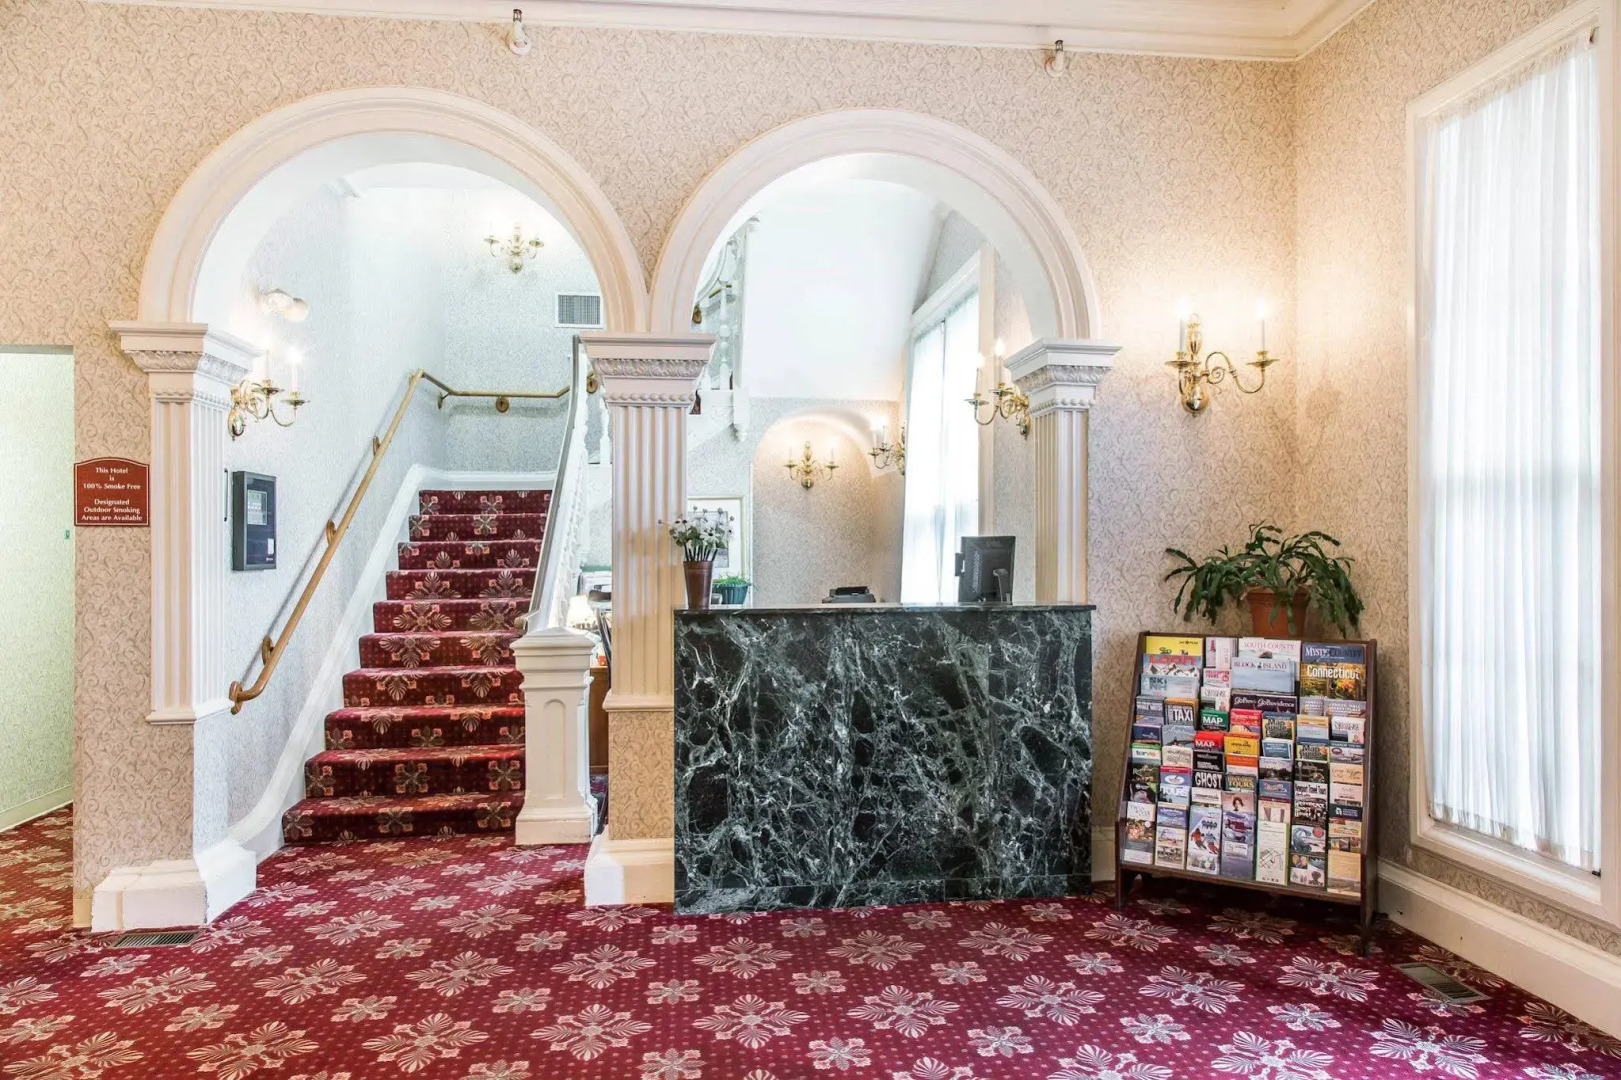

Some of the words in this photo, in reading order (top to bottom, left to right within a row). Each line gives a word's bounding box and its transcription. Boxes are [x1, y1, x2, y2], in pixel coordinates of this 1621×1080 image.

[94, 498, 130, 506] Designated
[1307, 664, 1360, 680] Connecticut
[1174, 709, 1193, 722] TAXI
[1195, 772, 1222, 788] GHOST
